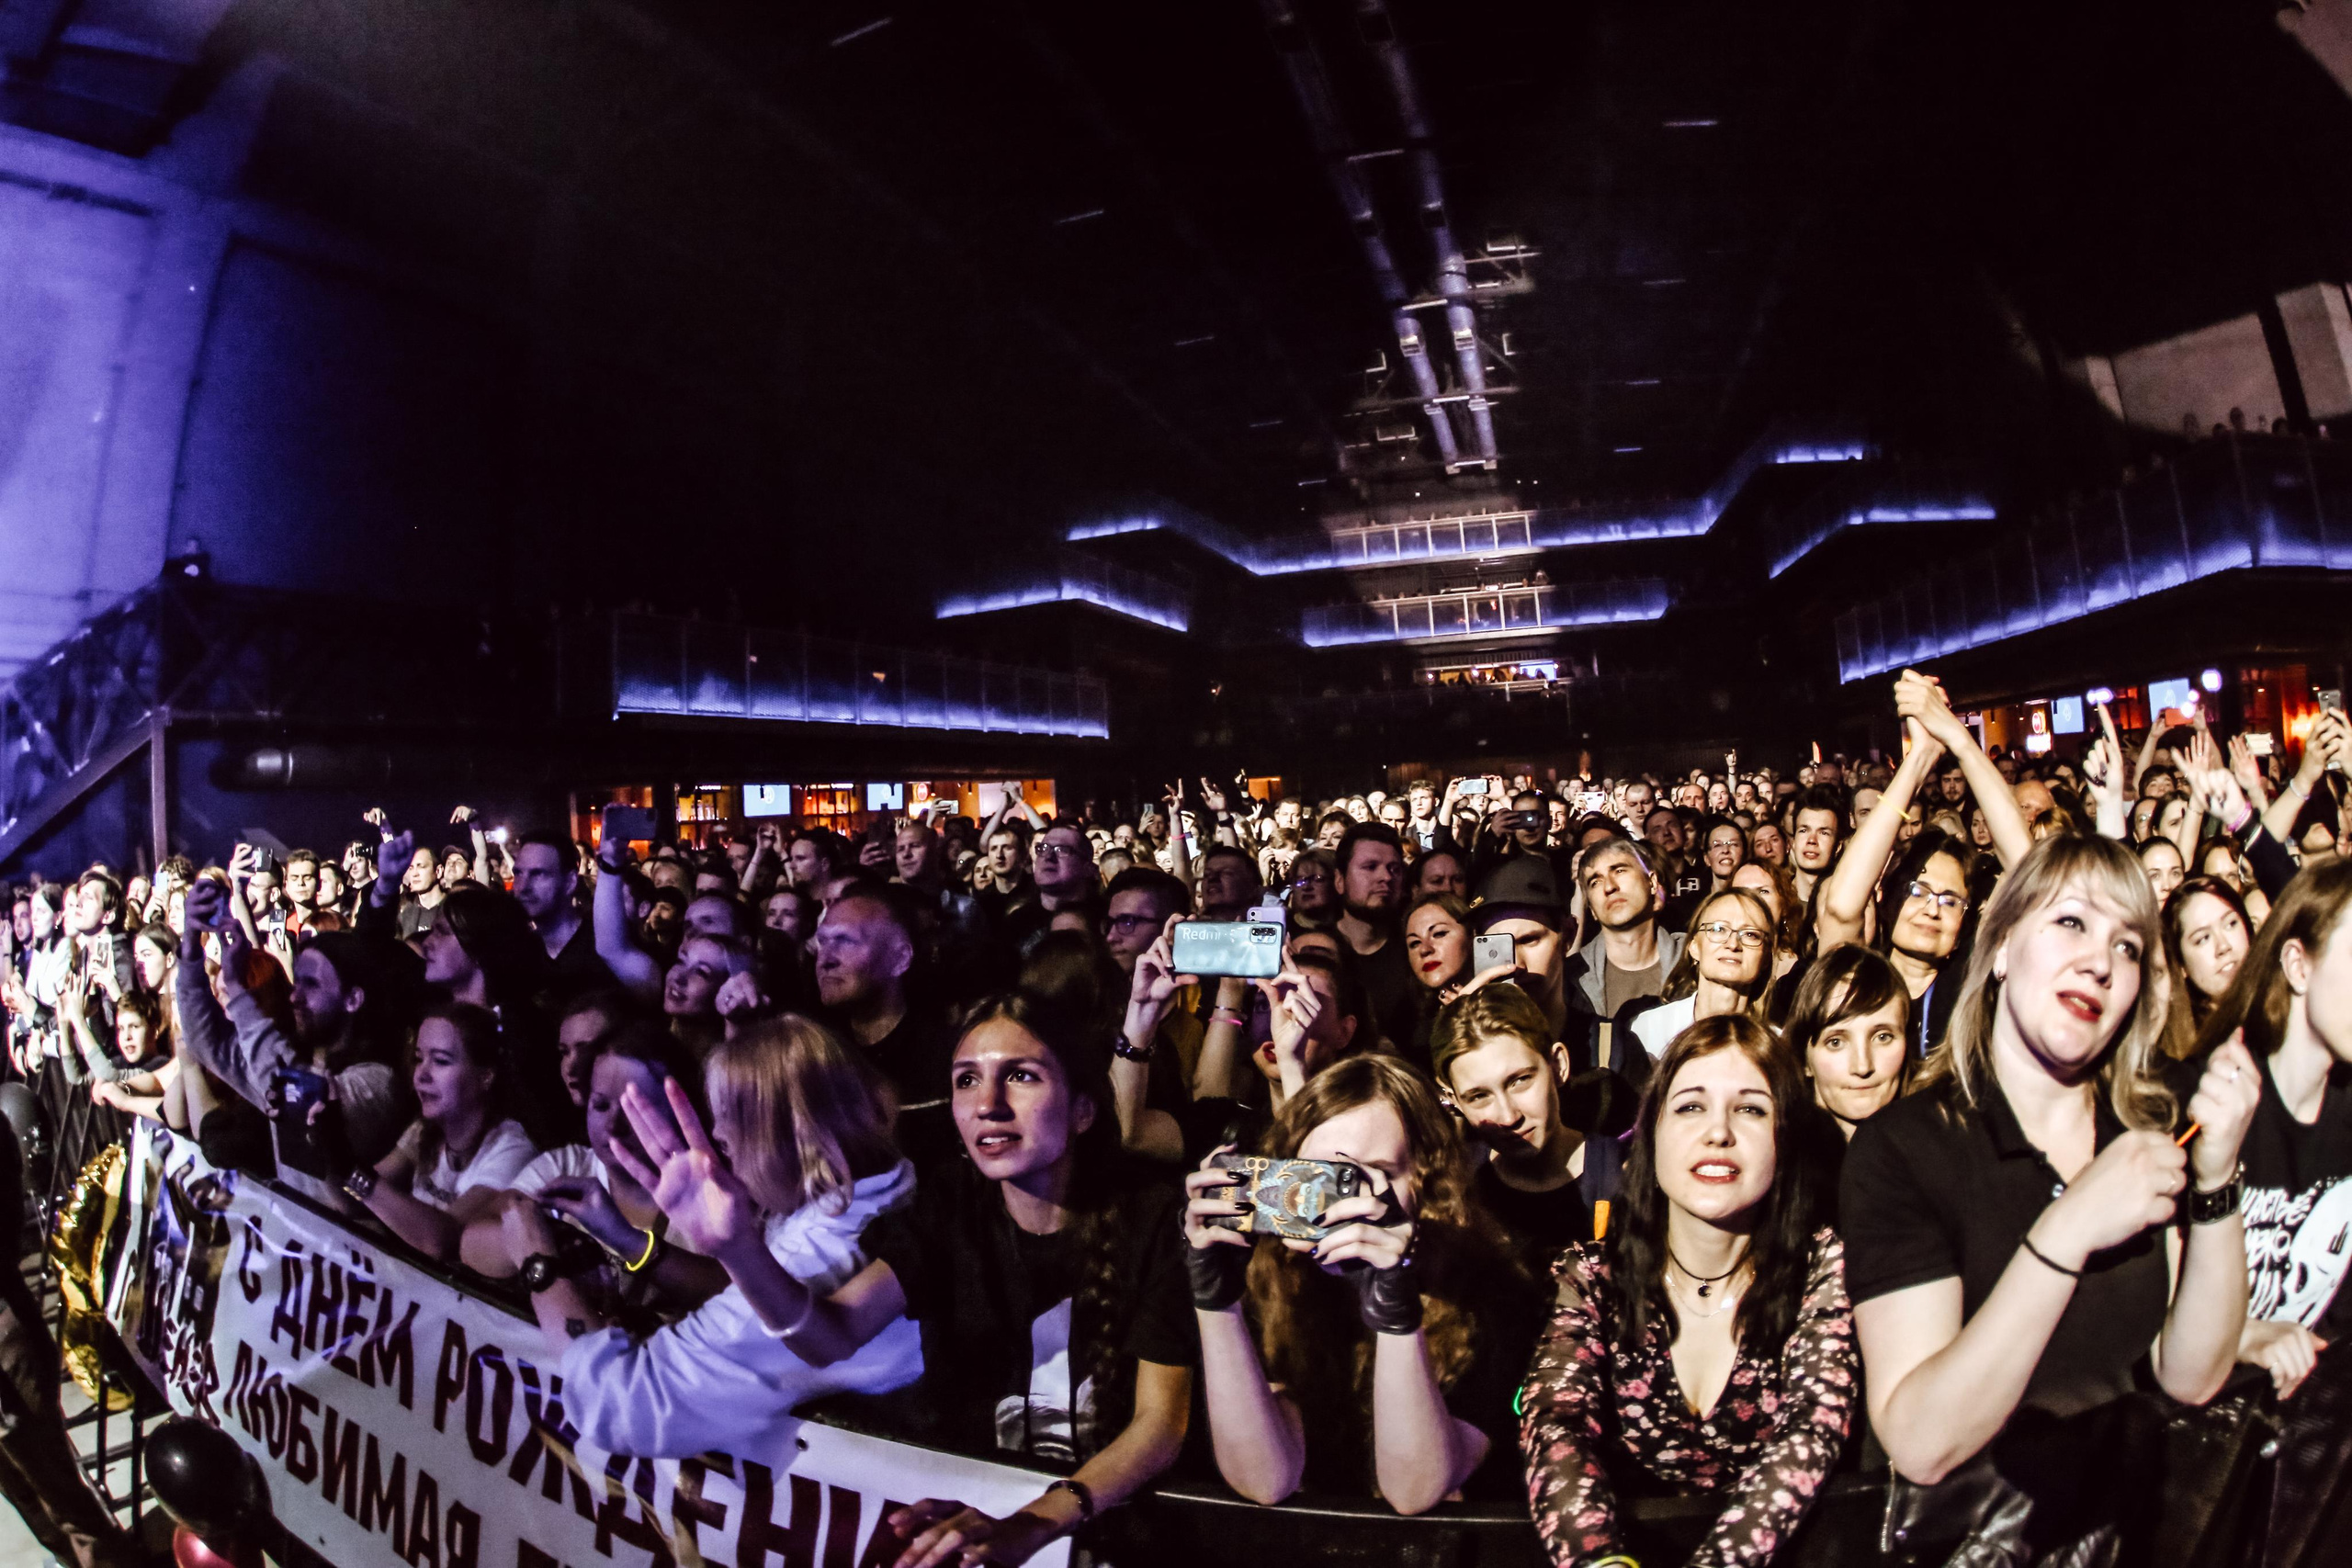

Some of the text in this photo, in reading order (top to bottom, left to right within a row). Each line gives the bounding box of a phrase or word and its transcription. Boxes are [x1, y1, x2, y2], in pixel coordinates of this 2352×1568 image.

[1182, 927, 1221, 942] Redmi
[239, 1214, 264, 1304] С
[271, 1240, 421, 1410] ДНЁМ
[223, 1340, 481, 1568] ЛЮБИМАЯ
